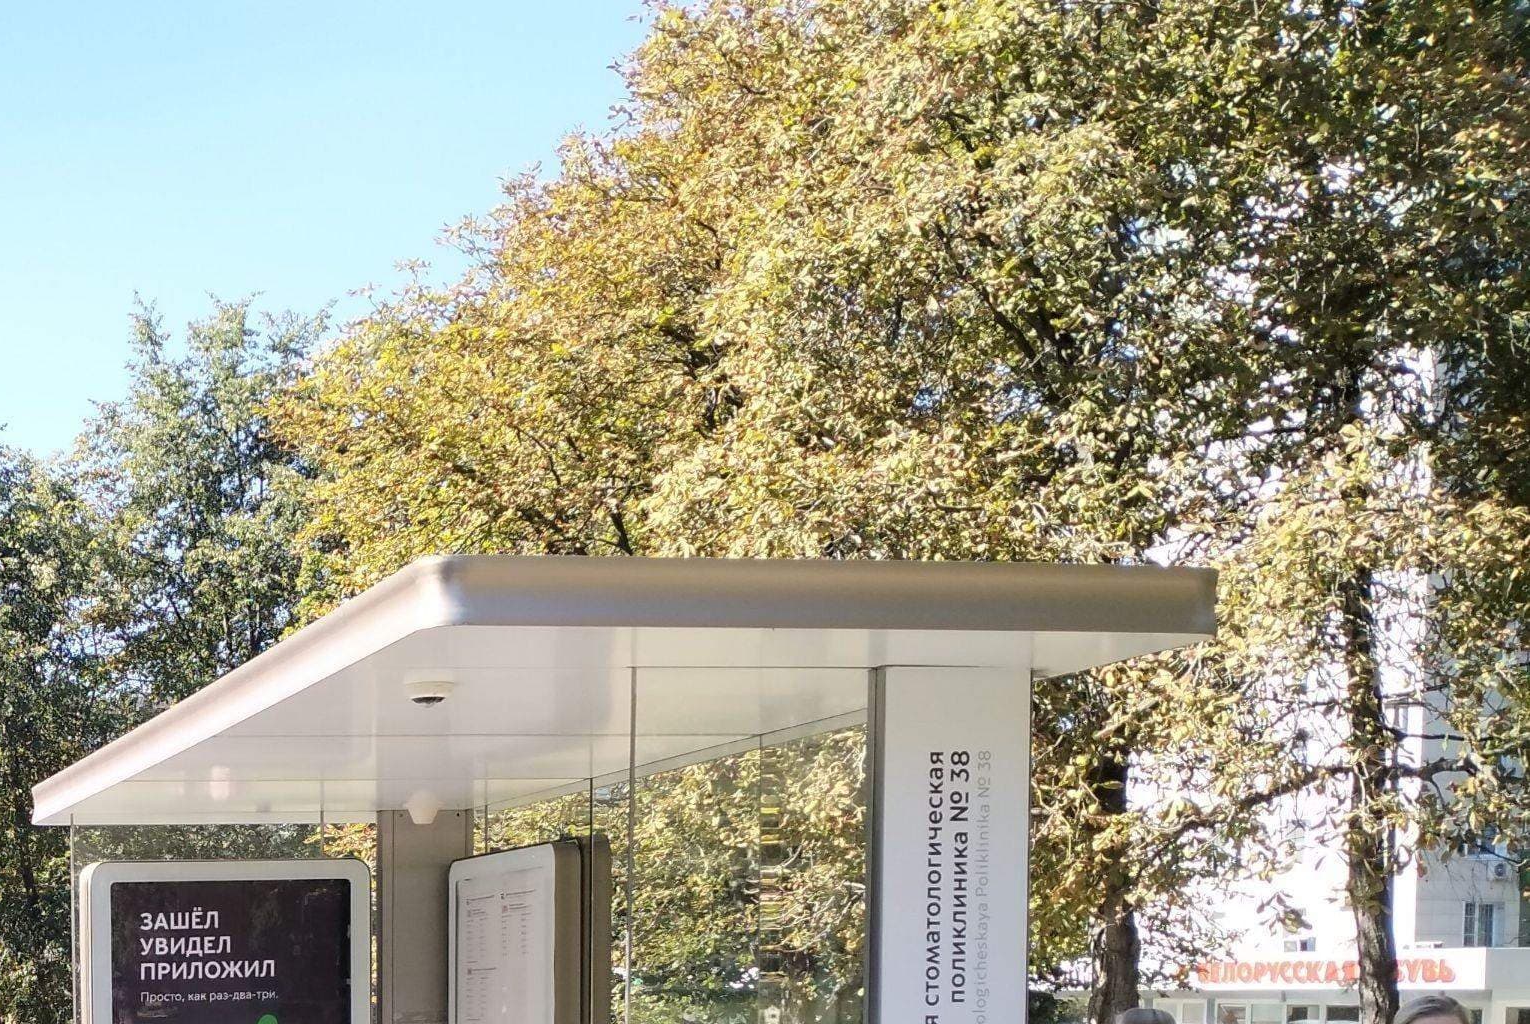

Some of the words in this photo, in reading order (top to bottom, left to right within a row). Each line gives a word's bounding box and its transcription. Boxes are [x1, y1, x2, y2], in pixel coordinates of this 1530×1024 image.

[950, 750, 970, 783] 38
[977, 750, 991, 771] 38
[950, 790, 969, 821] №
[975, 803, 990, 897] Poliklinika
[925, 751, 944, 1006] стоматологическая
[140, 907, 219, 931] ЗАШЁЛ
[951, 832, 969, 1003] поликлиника
[140, 936, 231, 957] УВИДЕЛ
[140, 960, 275, 980] ПРИЛОЖИЛ
[141, 992, 185, 1003] Просто,
[188, 993, 207, 1001] как
[210, 990, 279, 1002] раз-два-три.
